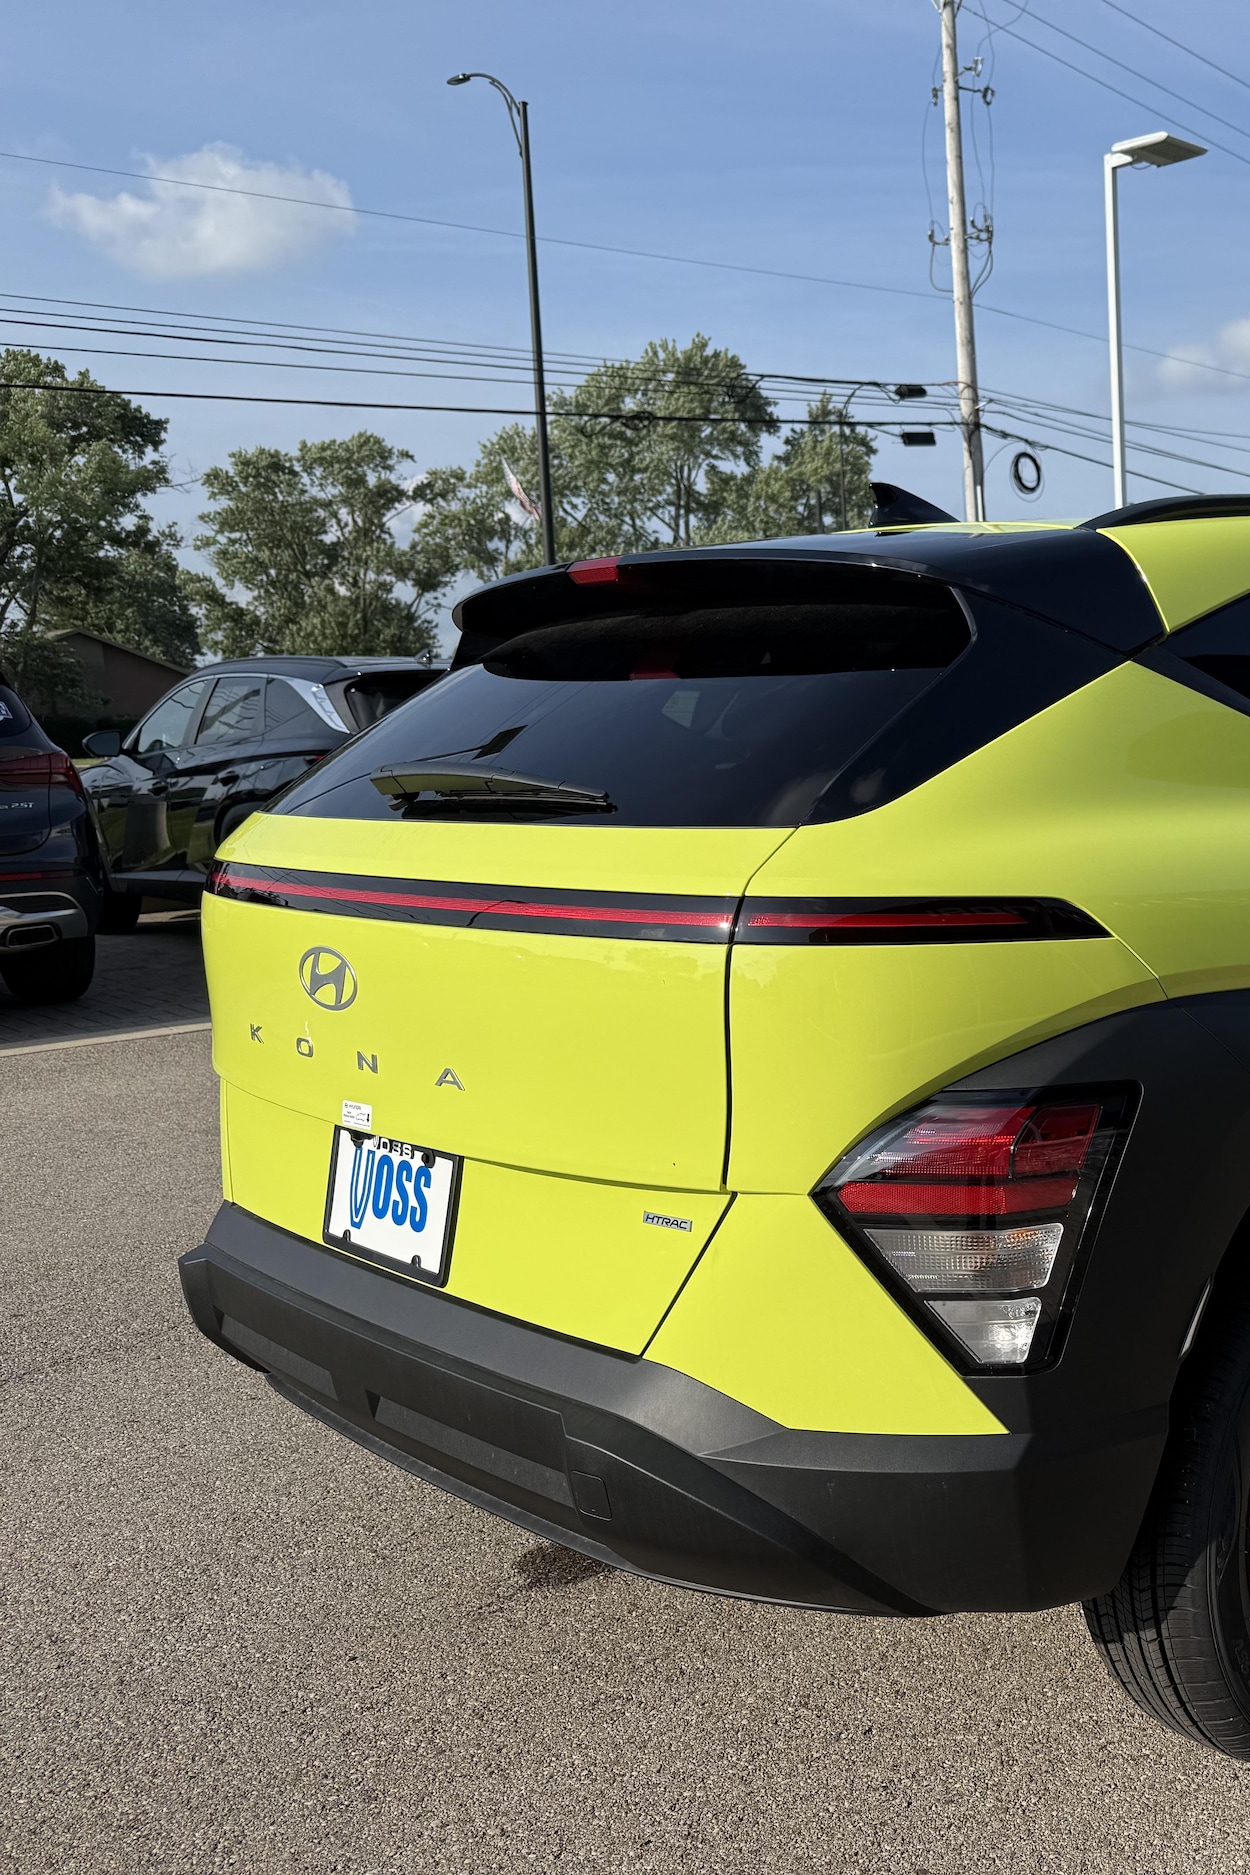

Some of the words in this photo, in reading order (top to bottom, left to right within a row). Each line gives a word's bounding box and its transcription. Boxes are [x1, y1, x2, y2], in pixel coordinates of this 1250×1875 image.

[250, 1023, 465, 1091] KONA
[350, 1147, 432, 1232] VOSS
[645, 1213, 688, 1230] HTRAC
